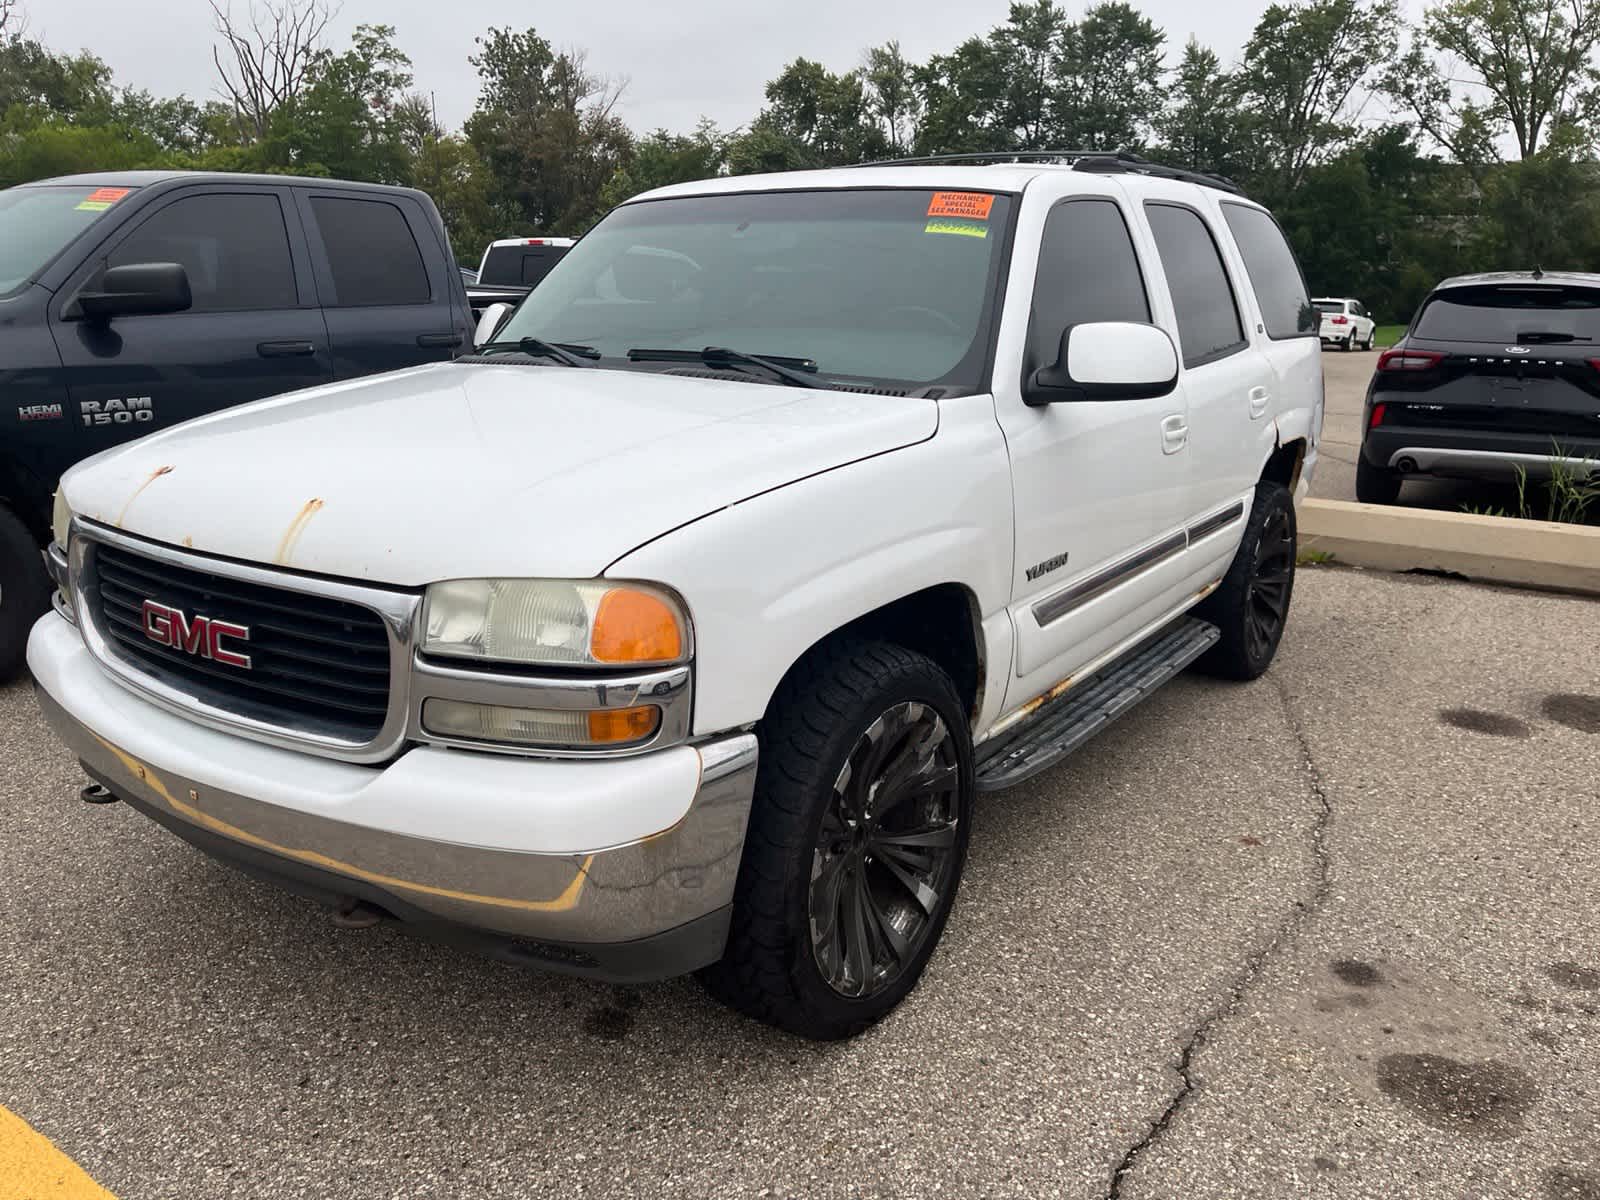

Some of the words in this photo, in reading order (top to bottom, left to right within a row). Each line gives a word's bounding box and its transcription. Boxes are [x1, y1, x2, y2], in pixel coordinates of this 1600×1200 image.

[947, 207, 986, 216] MANAGER
[18, 404, 62, 415] HEMI
[80, 396, 152, 412] RAM
[82, 410, 153, 426] 1500
[1026, 552, 1068, 581] YUKON
[142, 599, 252, 670] GMC
